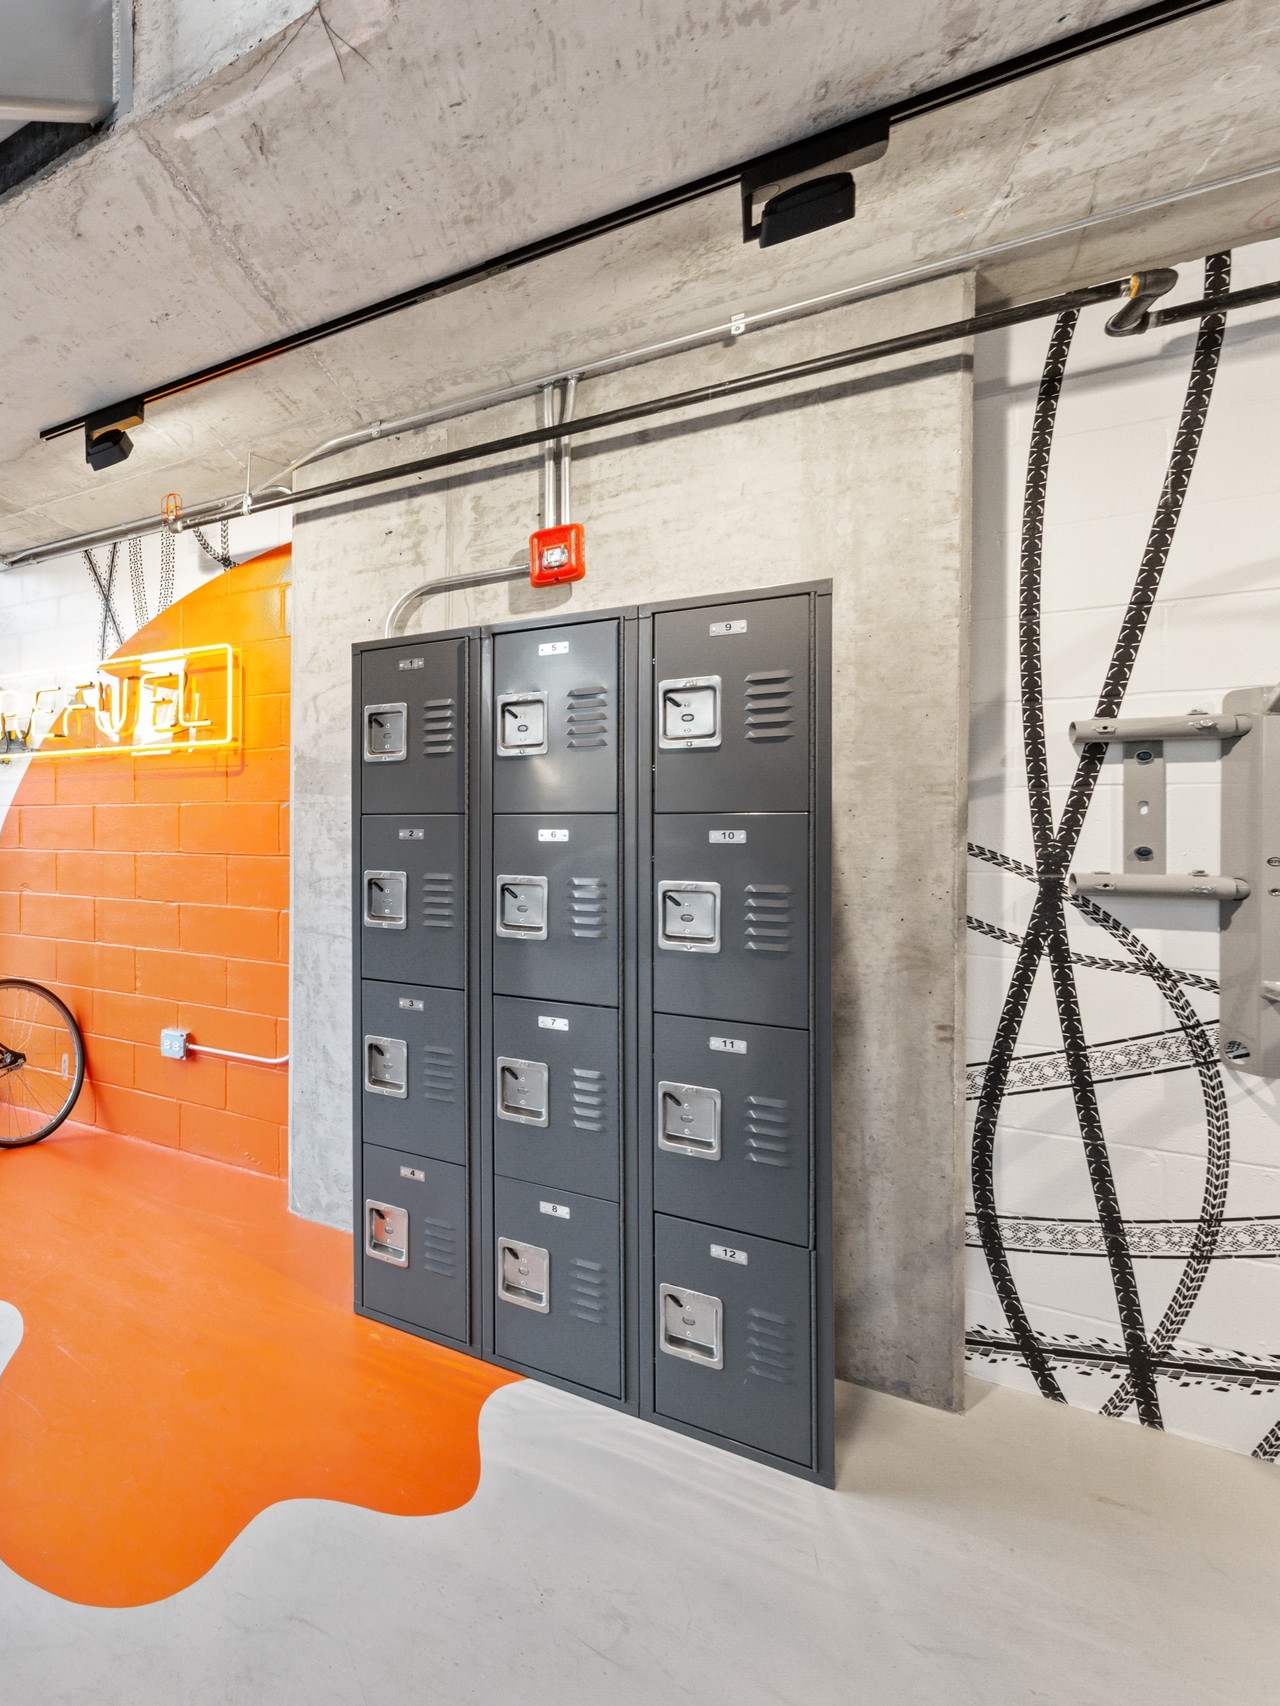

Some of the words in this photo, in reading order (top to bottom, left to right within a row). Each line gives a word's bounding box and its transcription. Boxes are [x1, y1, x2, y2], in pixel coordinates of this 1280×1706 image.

[725, 623, 732, 631] 9
[722, 832, 735, 840] 10
[550, 1018, 556, 1026] 7
[722, 1040, 734, 1048] 11
[551, 1205, 557, 1213] 8
[723, 1249, 736, 1259] 12
